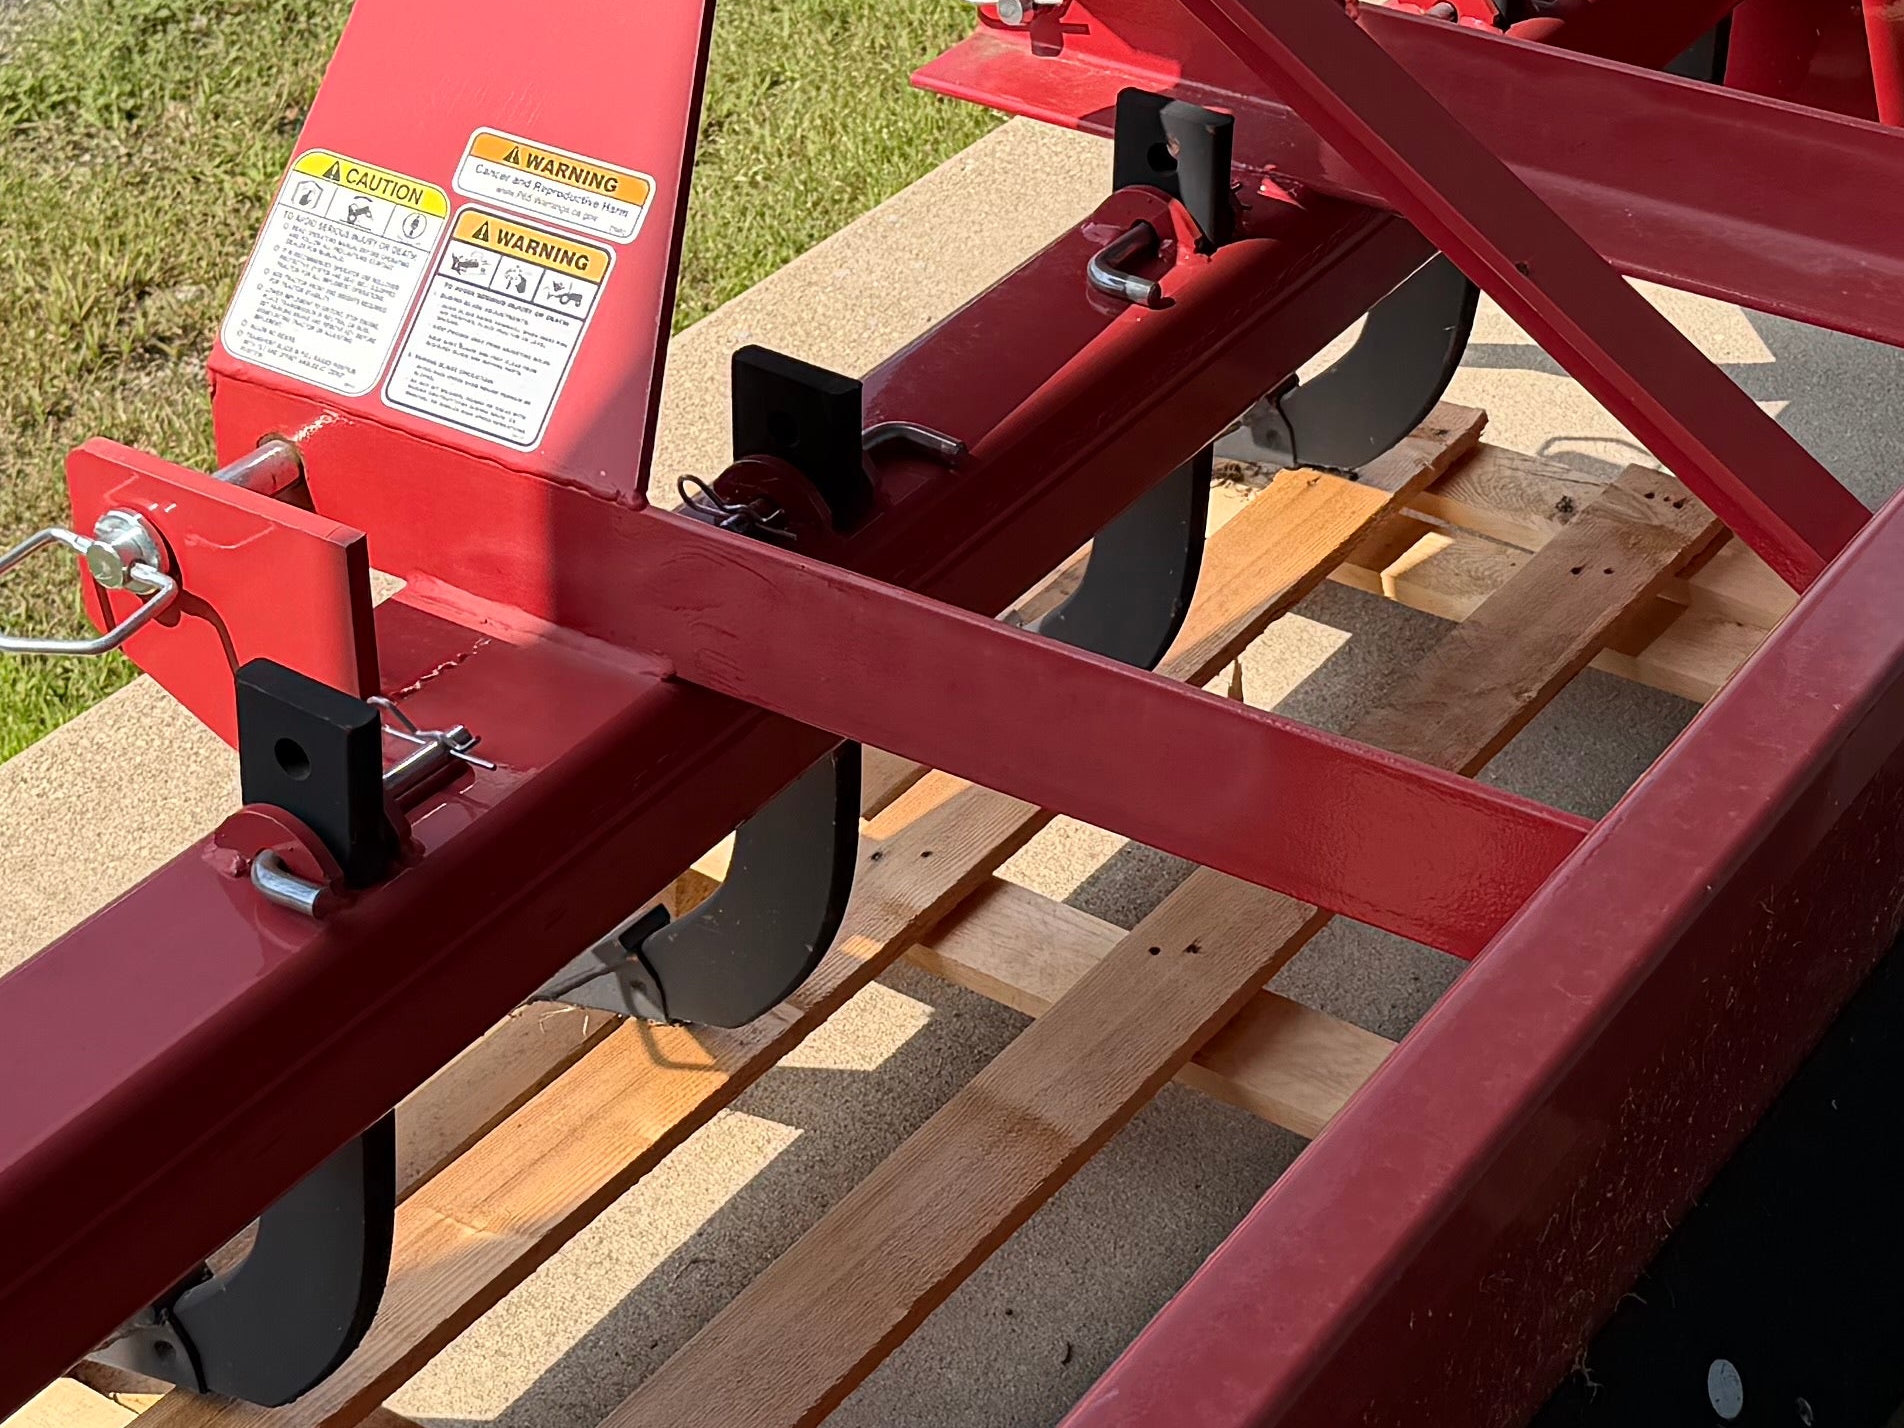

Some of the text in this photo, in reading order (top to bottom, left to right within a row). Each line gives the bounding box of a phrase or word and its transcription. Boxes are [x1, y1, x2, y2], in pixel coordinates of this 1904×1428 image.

[345, 168, 424, 205] CAUTION
[475, 163, 512, 184] Cancer
[512, 176, 530, 189] and
[602, 201, 630, 218] Harm
[526, 152, 619, 193] WARNING
[496, 228, 590, 271] WARNING
